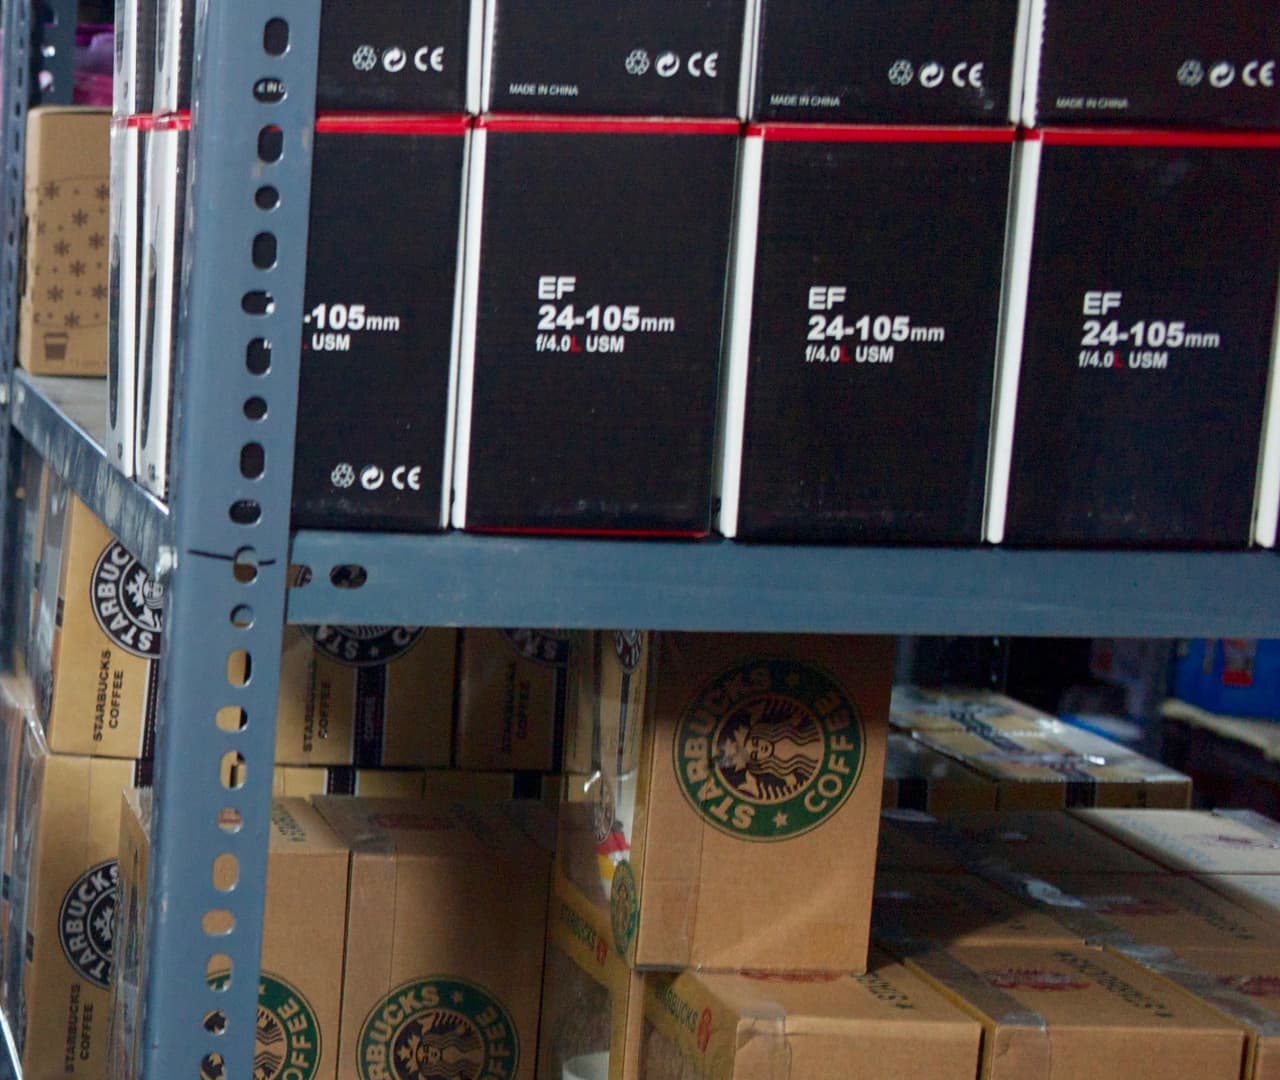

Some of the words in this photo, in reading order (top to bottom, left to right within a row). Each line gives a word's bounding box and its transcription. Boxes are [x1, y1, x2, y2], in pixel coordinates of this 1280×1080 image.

[509, 82, 536, 96] MADE
[537, 83, 549, 96] IN
[549, 84, 579, 97] CHINA
[769, 94, 798, 107] MADE
[799, 95, 810, 107] IN
[810, 95, 841, 107] CHINA
[1055, 96, 1084, 109] MADE
[1086, 97, 1097, 109] IN
[1097, 97, 1129, 110] CHINA
[538, 276, 577, 300] EF
[808, 286, 847, 310] EF
[1083, 291, 1122, 315] EF
[304, 303, 400, 331] -105mm
[537, 305, 675, 332] 24-105mm
[807, 315, 945, 342] 24-105mm
[312, 333, 351, 352] USM
[585, 336, 624, 353] USM
[1081, 321, 1221, 348] 24-105mm
[855, 346, 894, 363] USM
[1128, 351, 1168, 369] USM
[97, 546, 153, 651] STARBUC
[92, 649, 112, 742] STARBUCKS
[108, 670, 125, 729] COFFEE
[65, 865, 119, 980] TARBUCKS
[79, 1003, 94, 1060] COFFEE
